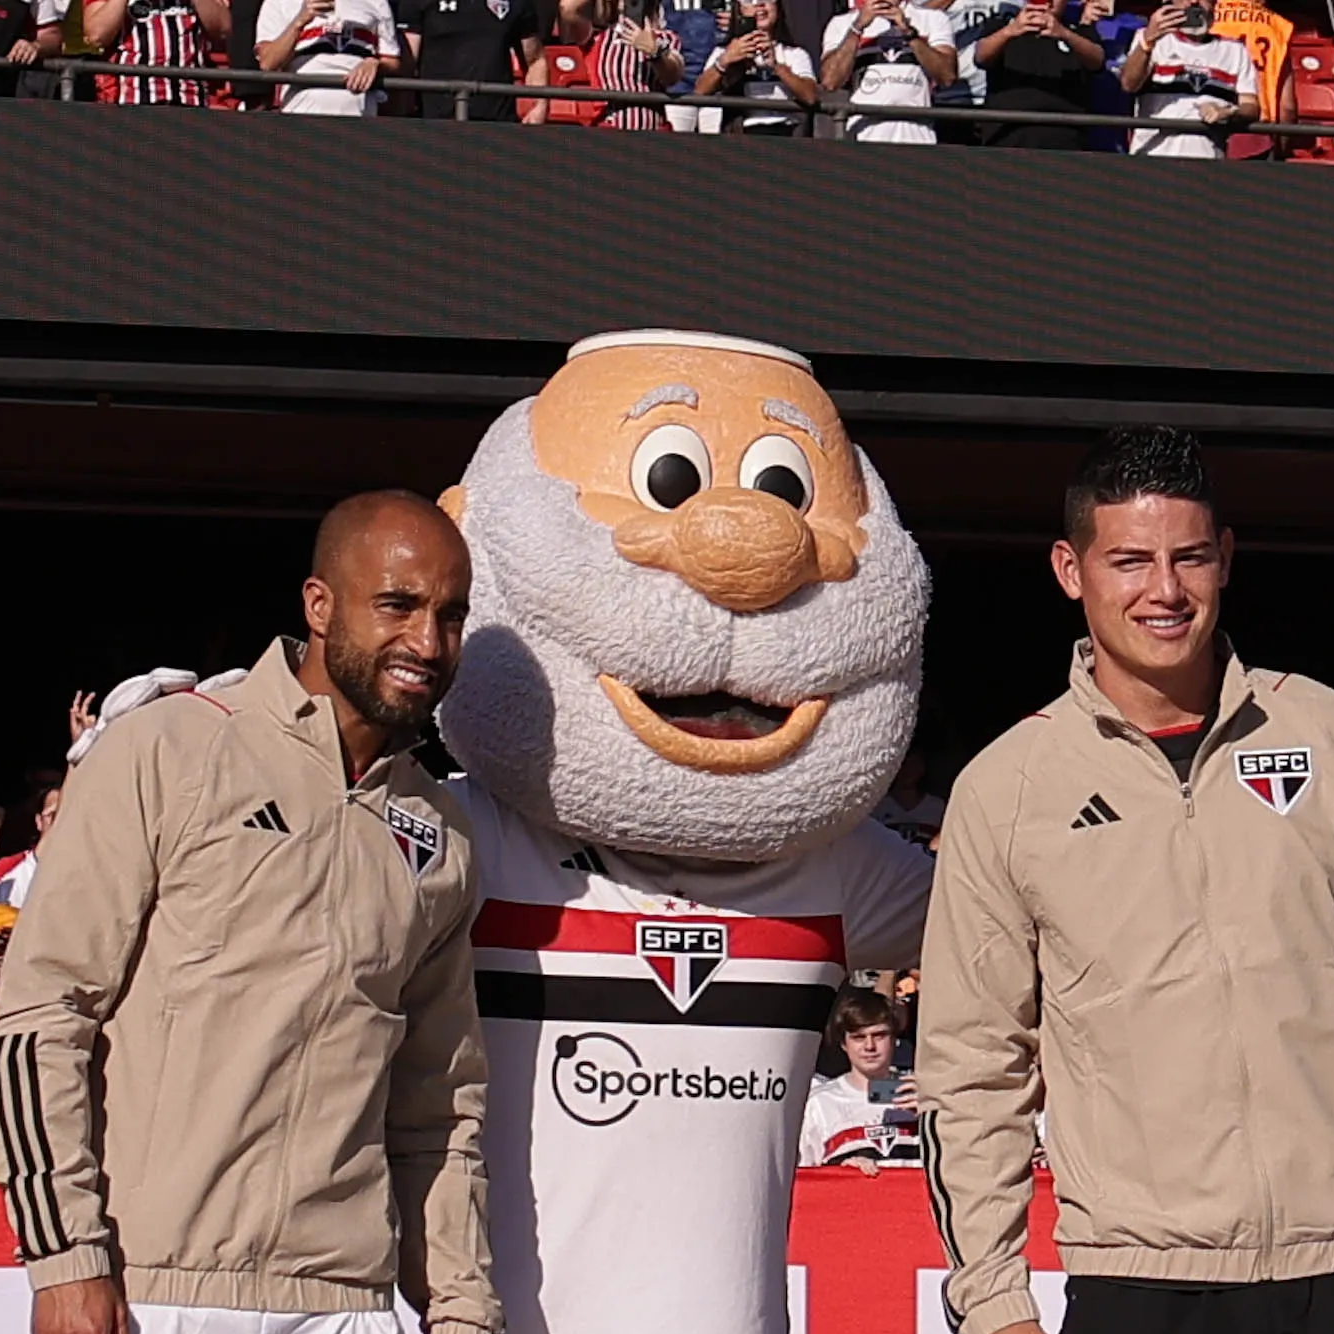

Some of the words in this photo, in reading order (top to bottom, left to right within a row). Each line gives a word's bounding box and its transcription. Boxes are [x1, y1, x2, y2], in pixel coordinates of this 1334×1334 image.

[1243, 754, 1305, 773] SPFC
[390, 810, 436, 846] SPFC
[643, 928, 722, 950] SPFC
[574, 1060, 787, 1103] Sportsbet.io
